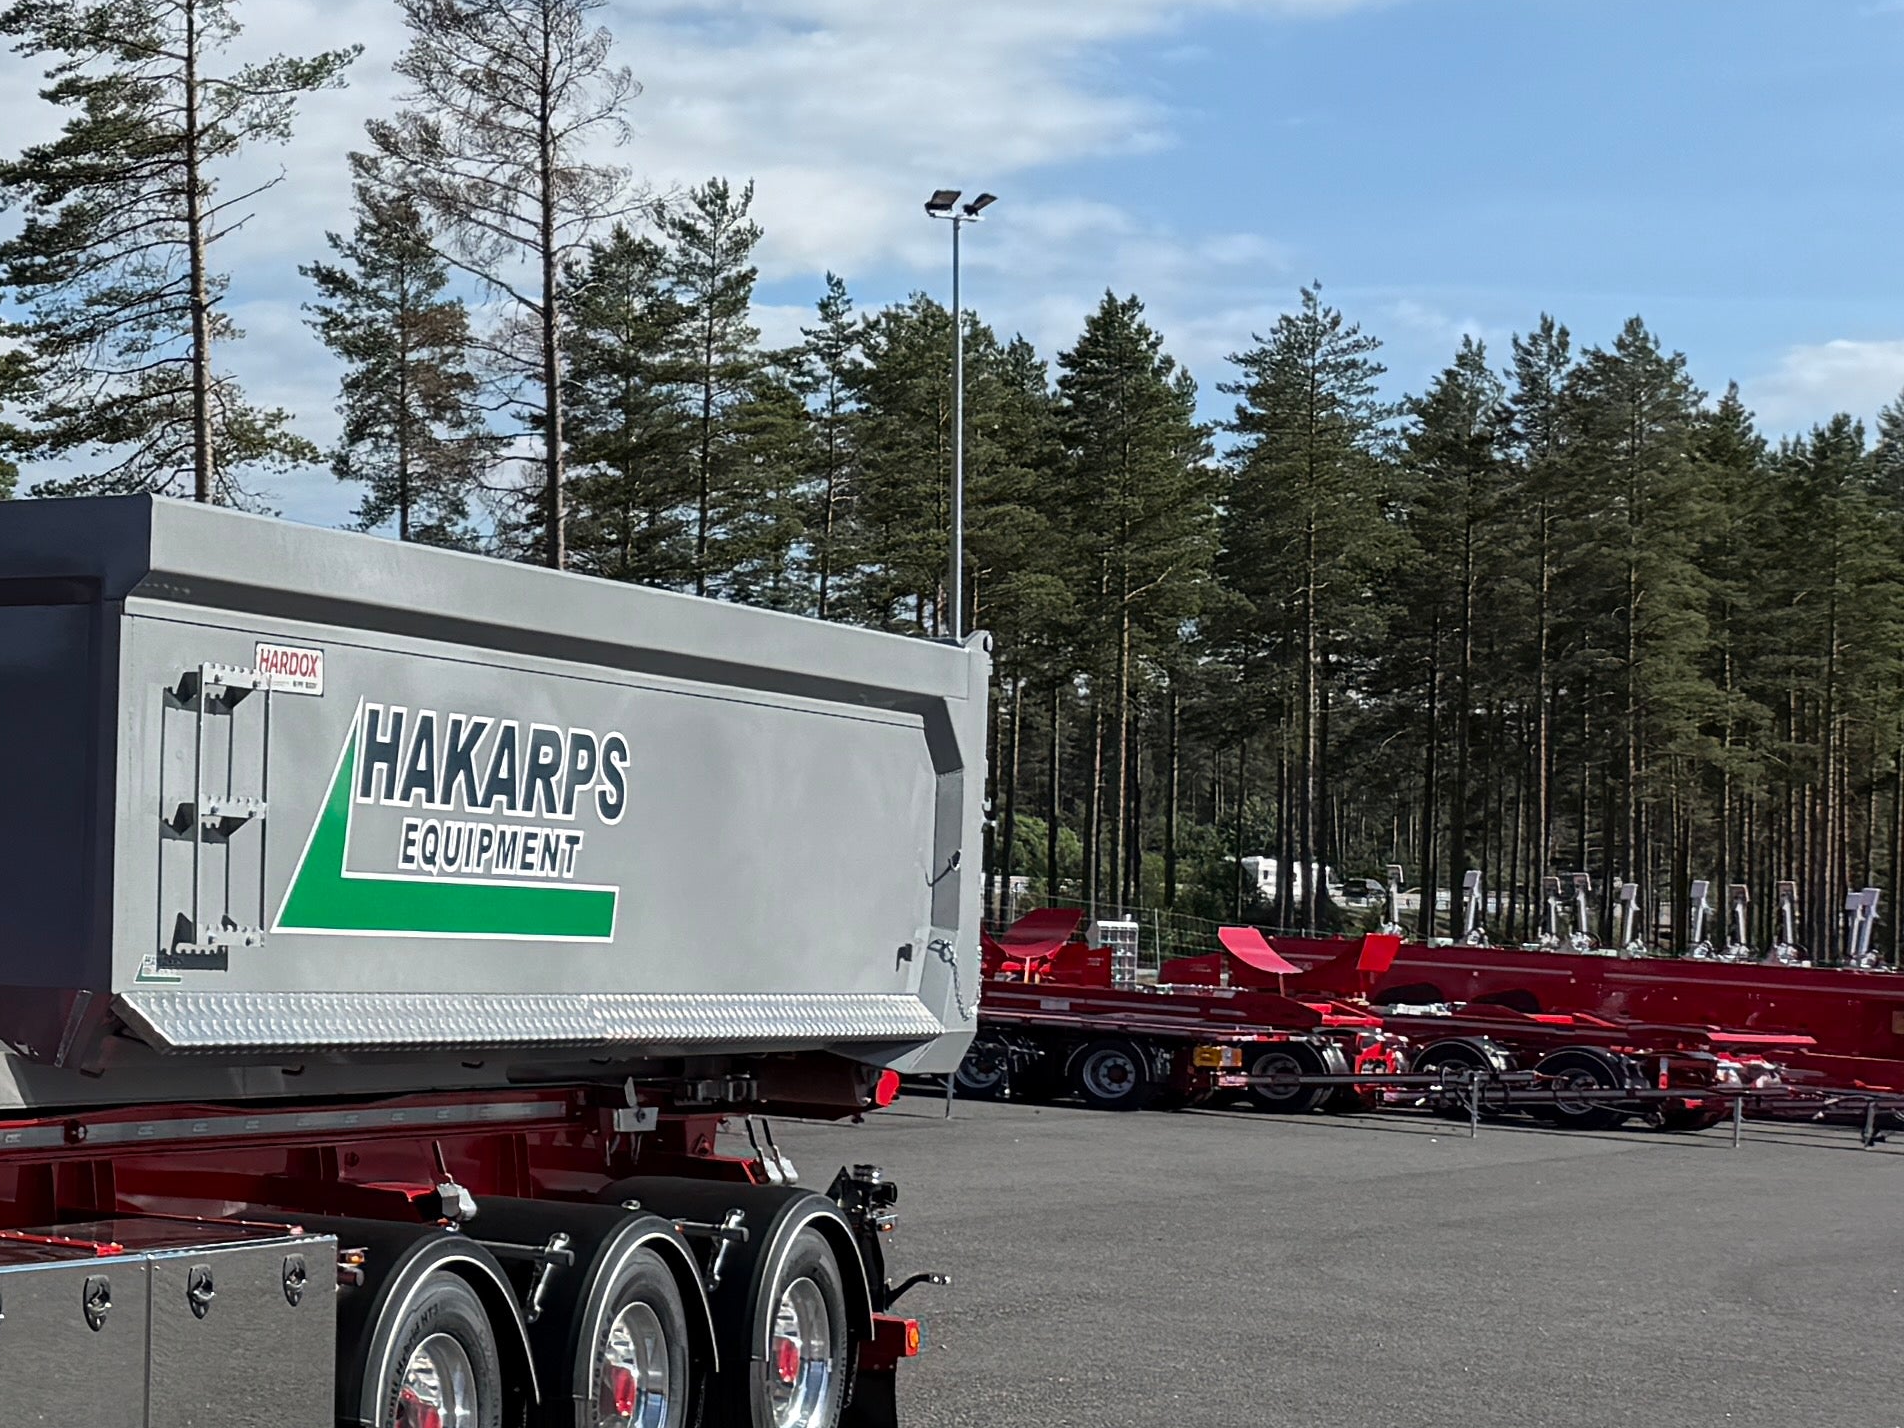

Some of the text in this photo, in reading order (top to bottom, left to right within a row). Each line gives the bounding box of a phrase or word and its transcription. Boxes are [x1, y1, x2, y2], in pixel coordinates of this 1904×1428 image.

[259, 648, 318, 678] HARDOX
[357, 703, 630, 824] HAKARPS
[398, 818, 583, 877] EQUIPMENT
